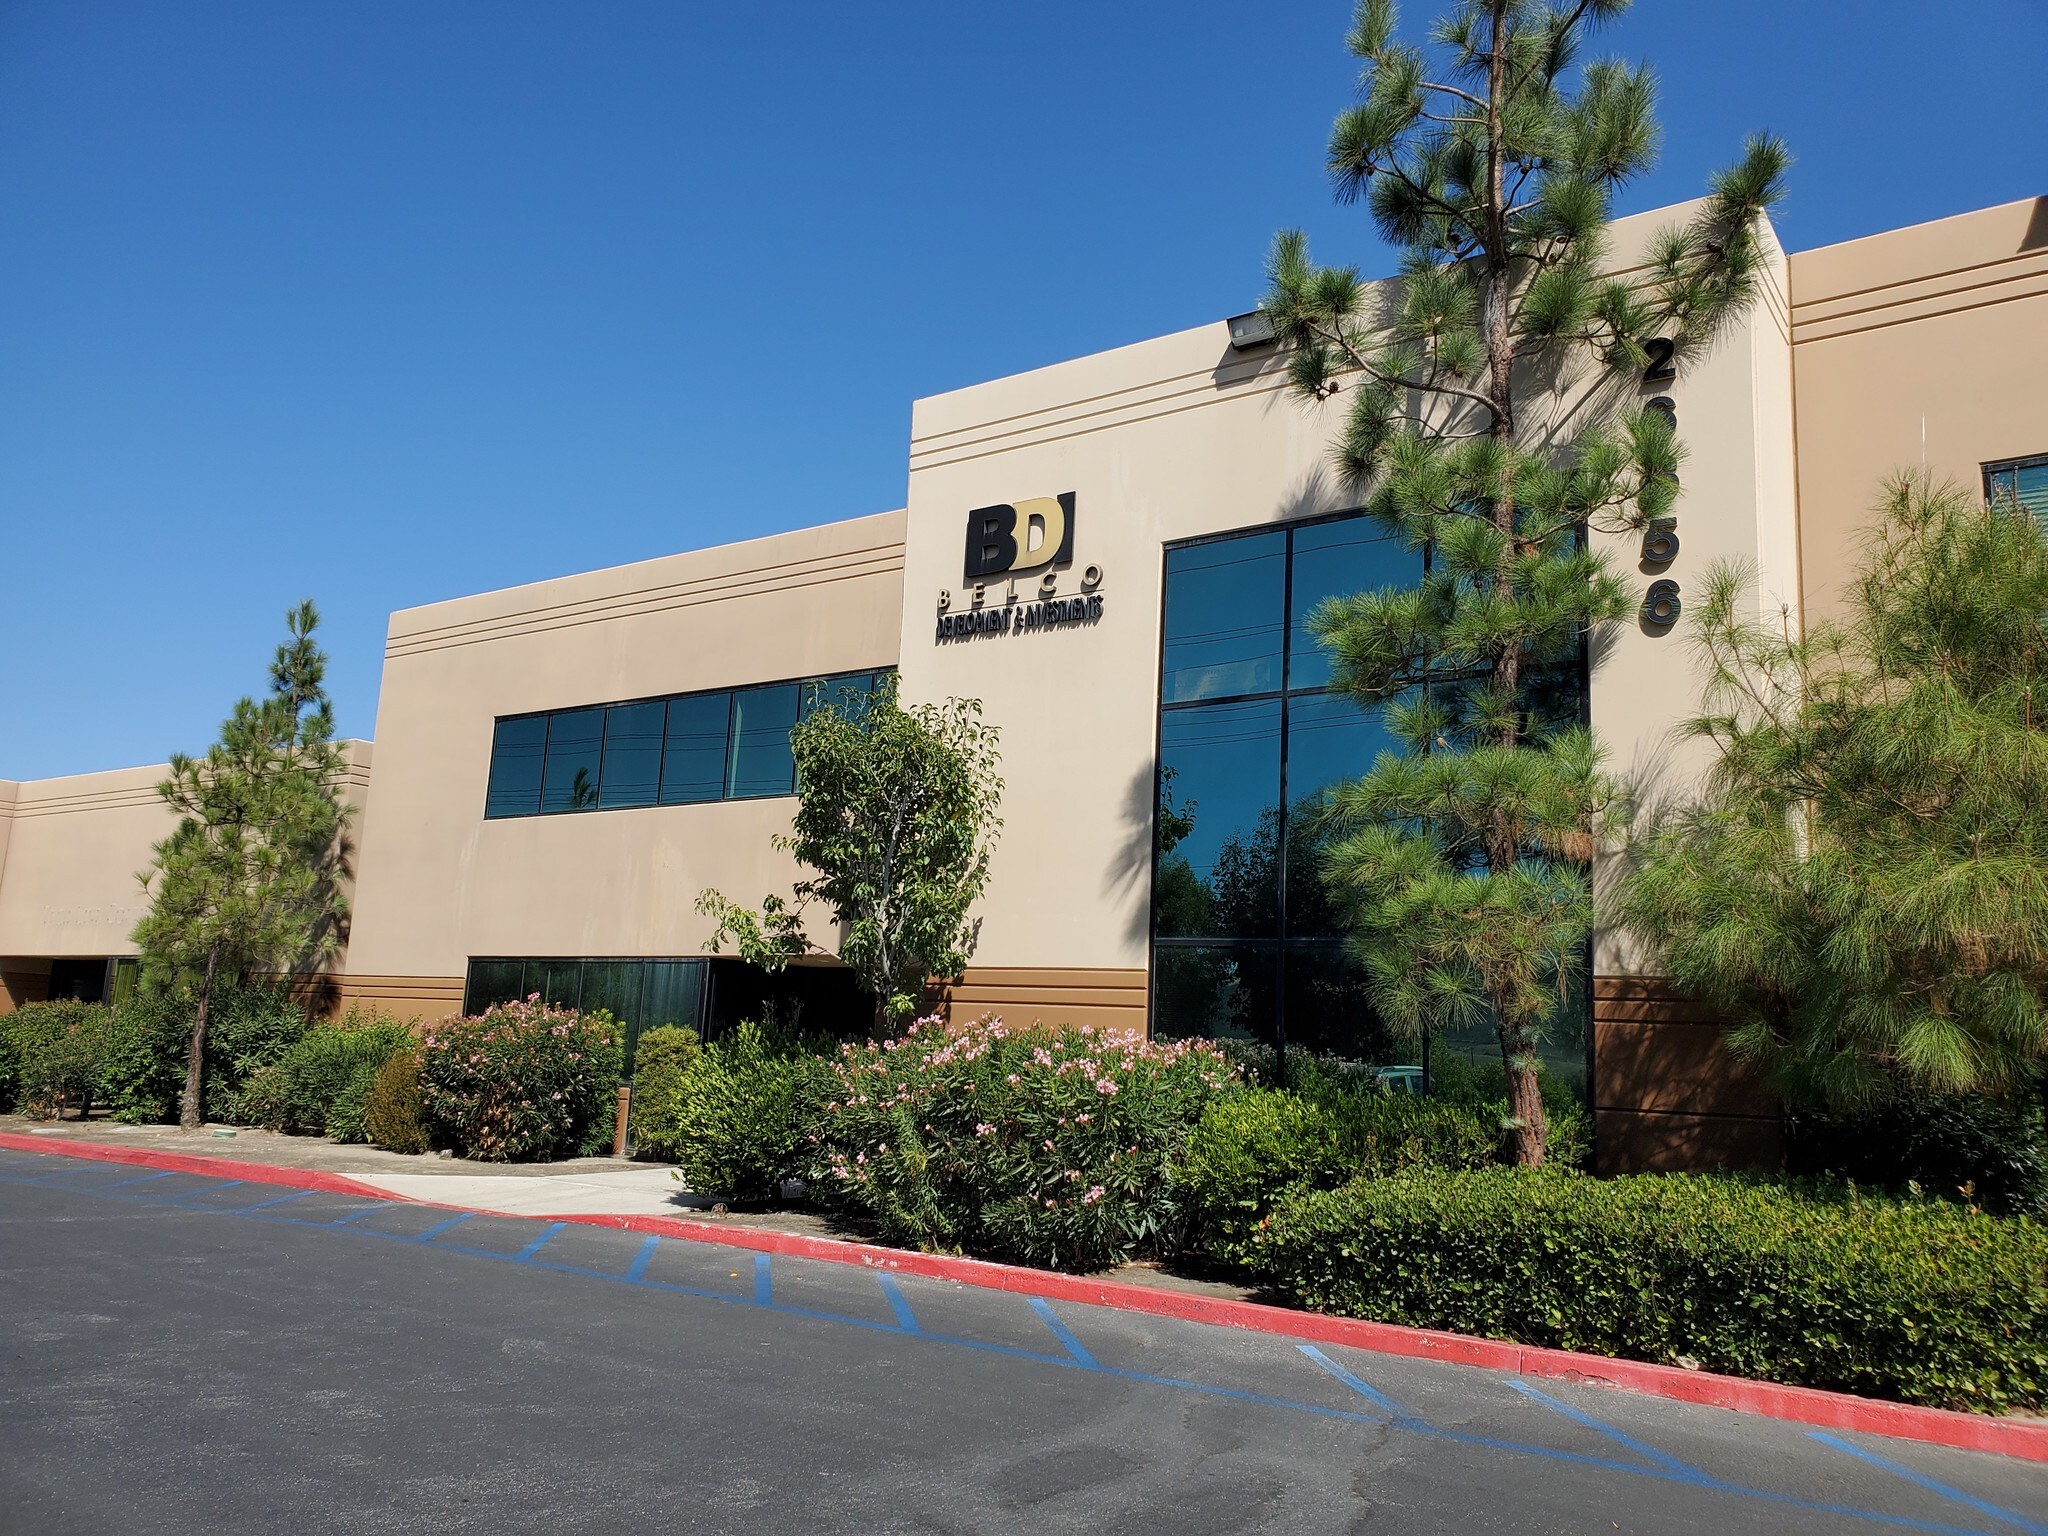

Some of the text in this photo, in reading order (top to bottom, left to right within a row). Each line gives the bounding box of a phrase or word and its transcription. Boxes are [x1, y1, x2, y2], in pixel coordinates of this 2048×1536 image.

[1642, 337, 1682, 626] 256
[966, 491, 1076, 577] BDI
[936, 595, 1104, 638] DEVELOPMENT & INVESTMENTS
[937, 563, 1103, 608] BELCO
